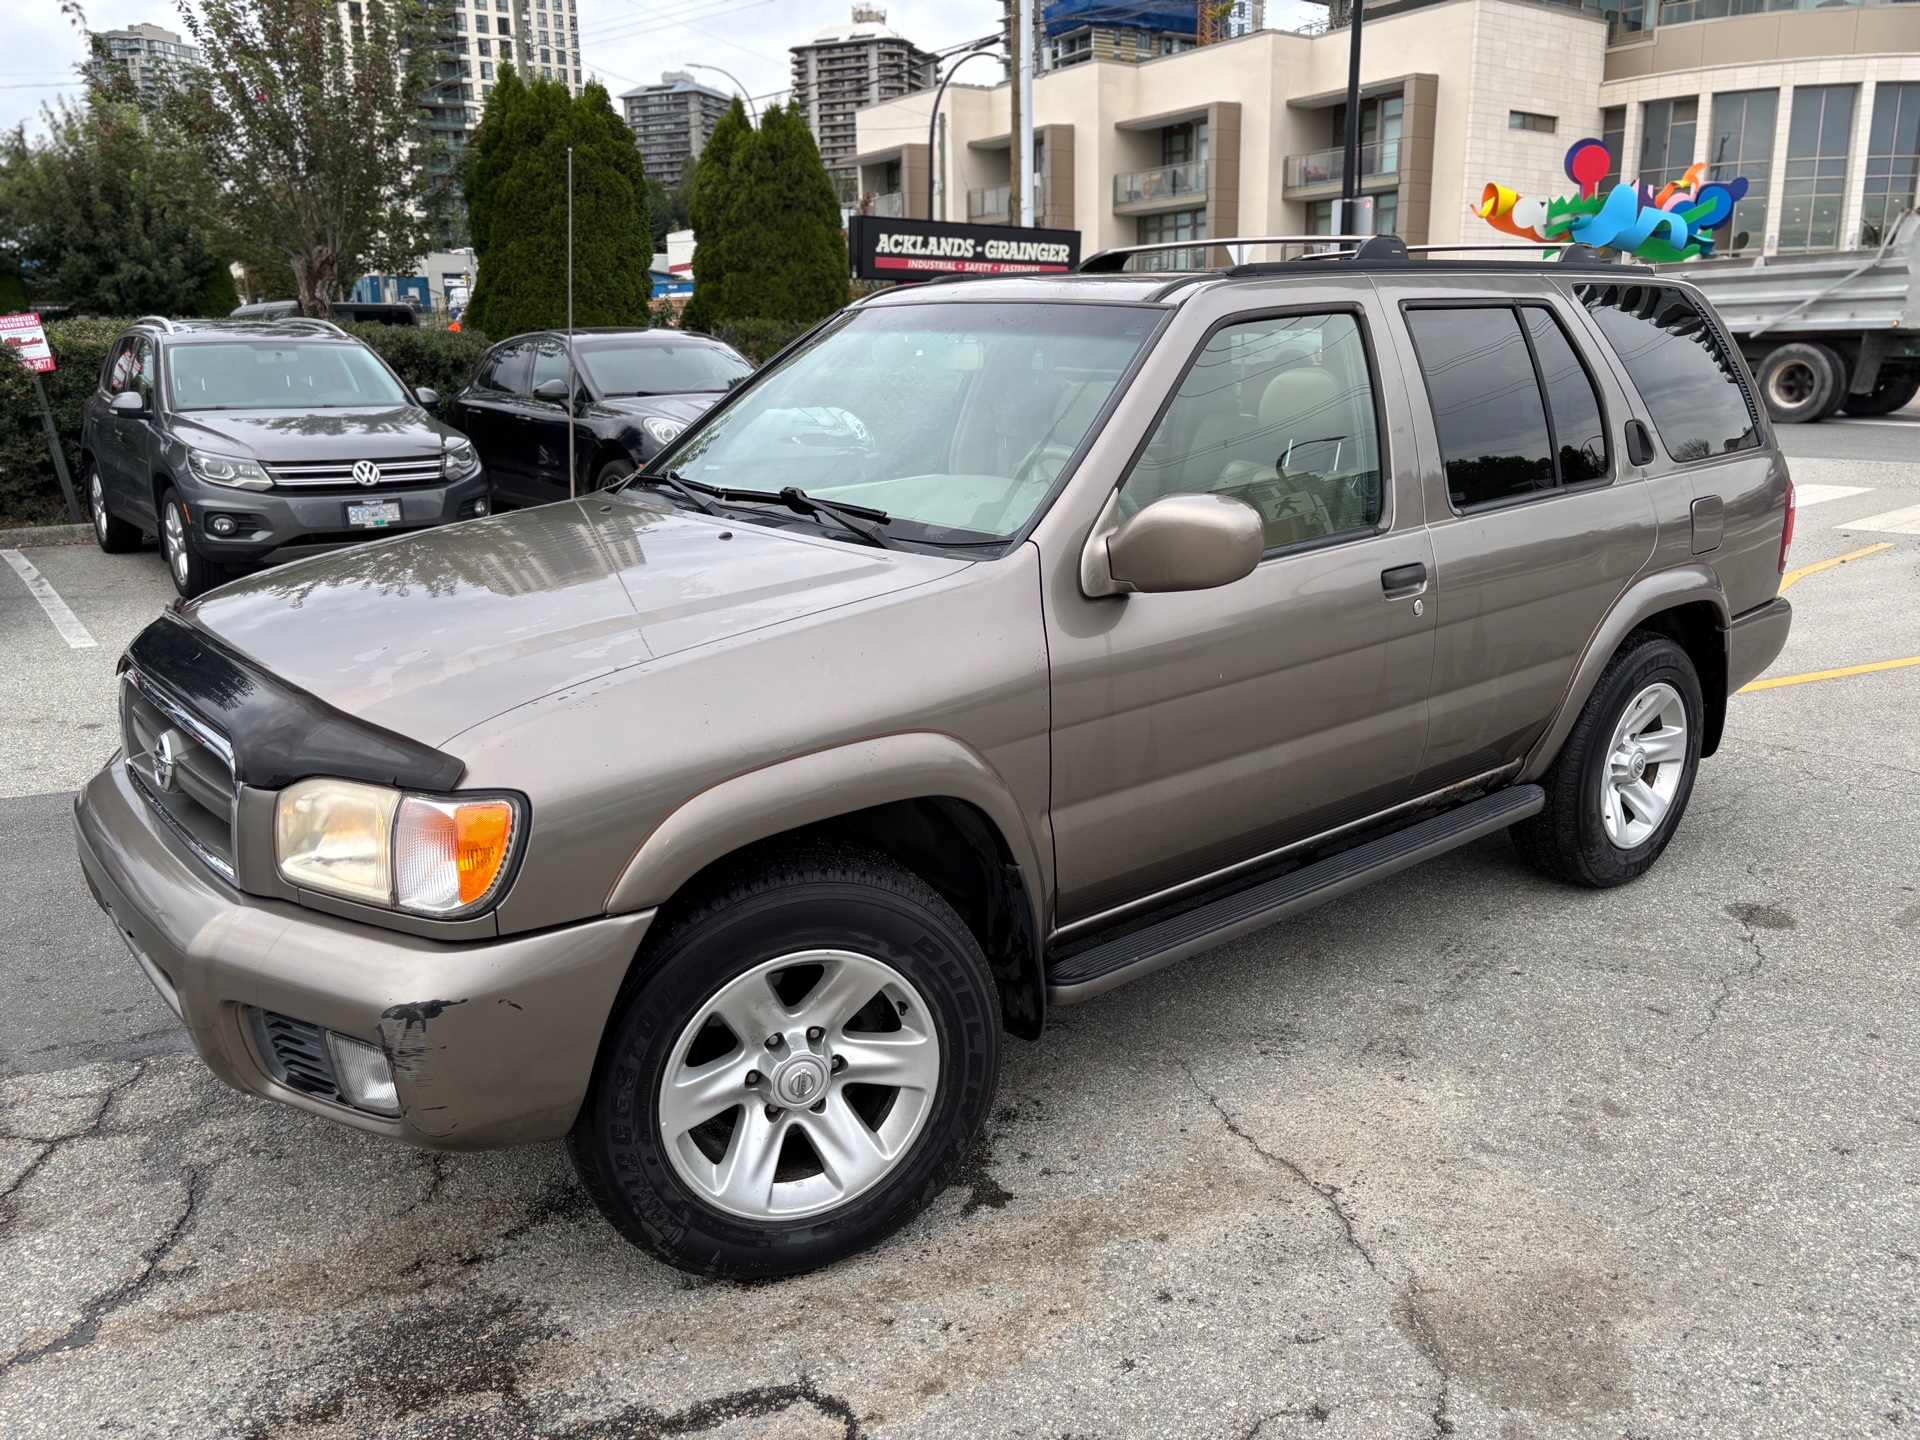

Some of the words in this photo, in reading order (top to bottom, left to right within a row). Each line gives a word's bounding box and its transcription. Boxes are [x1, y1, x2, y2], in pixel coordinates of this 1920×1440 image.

[907, 259, 956, 271] INDUSTRIAL
[964, 262, 992, 273] SAFETY
[912, 934, 985, 1120] DUELER
